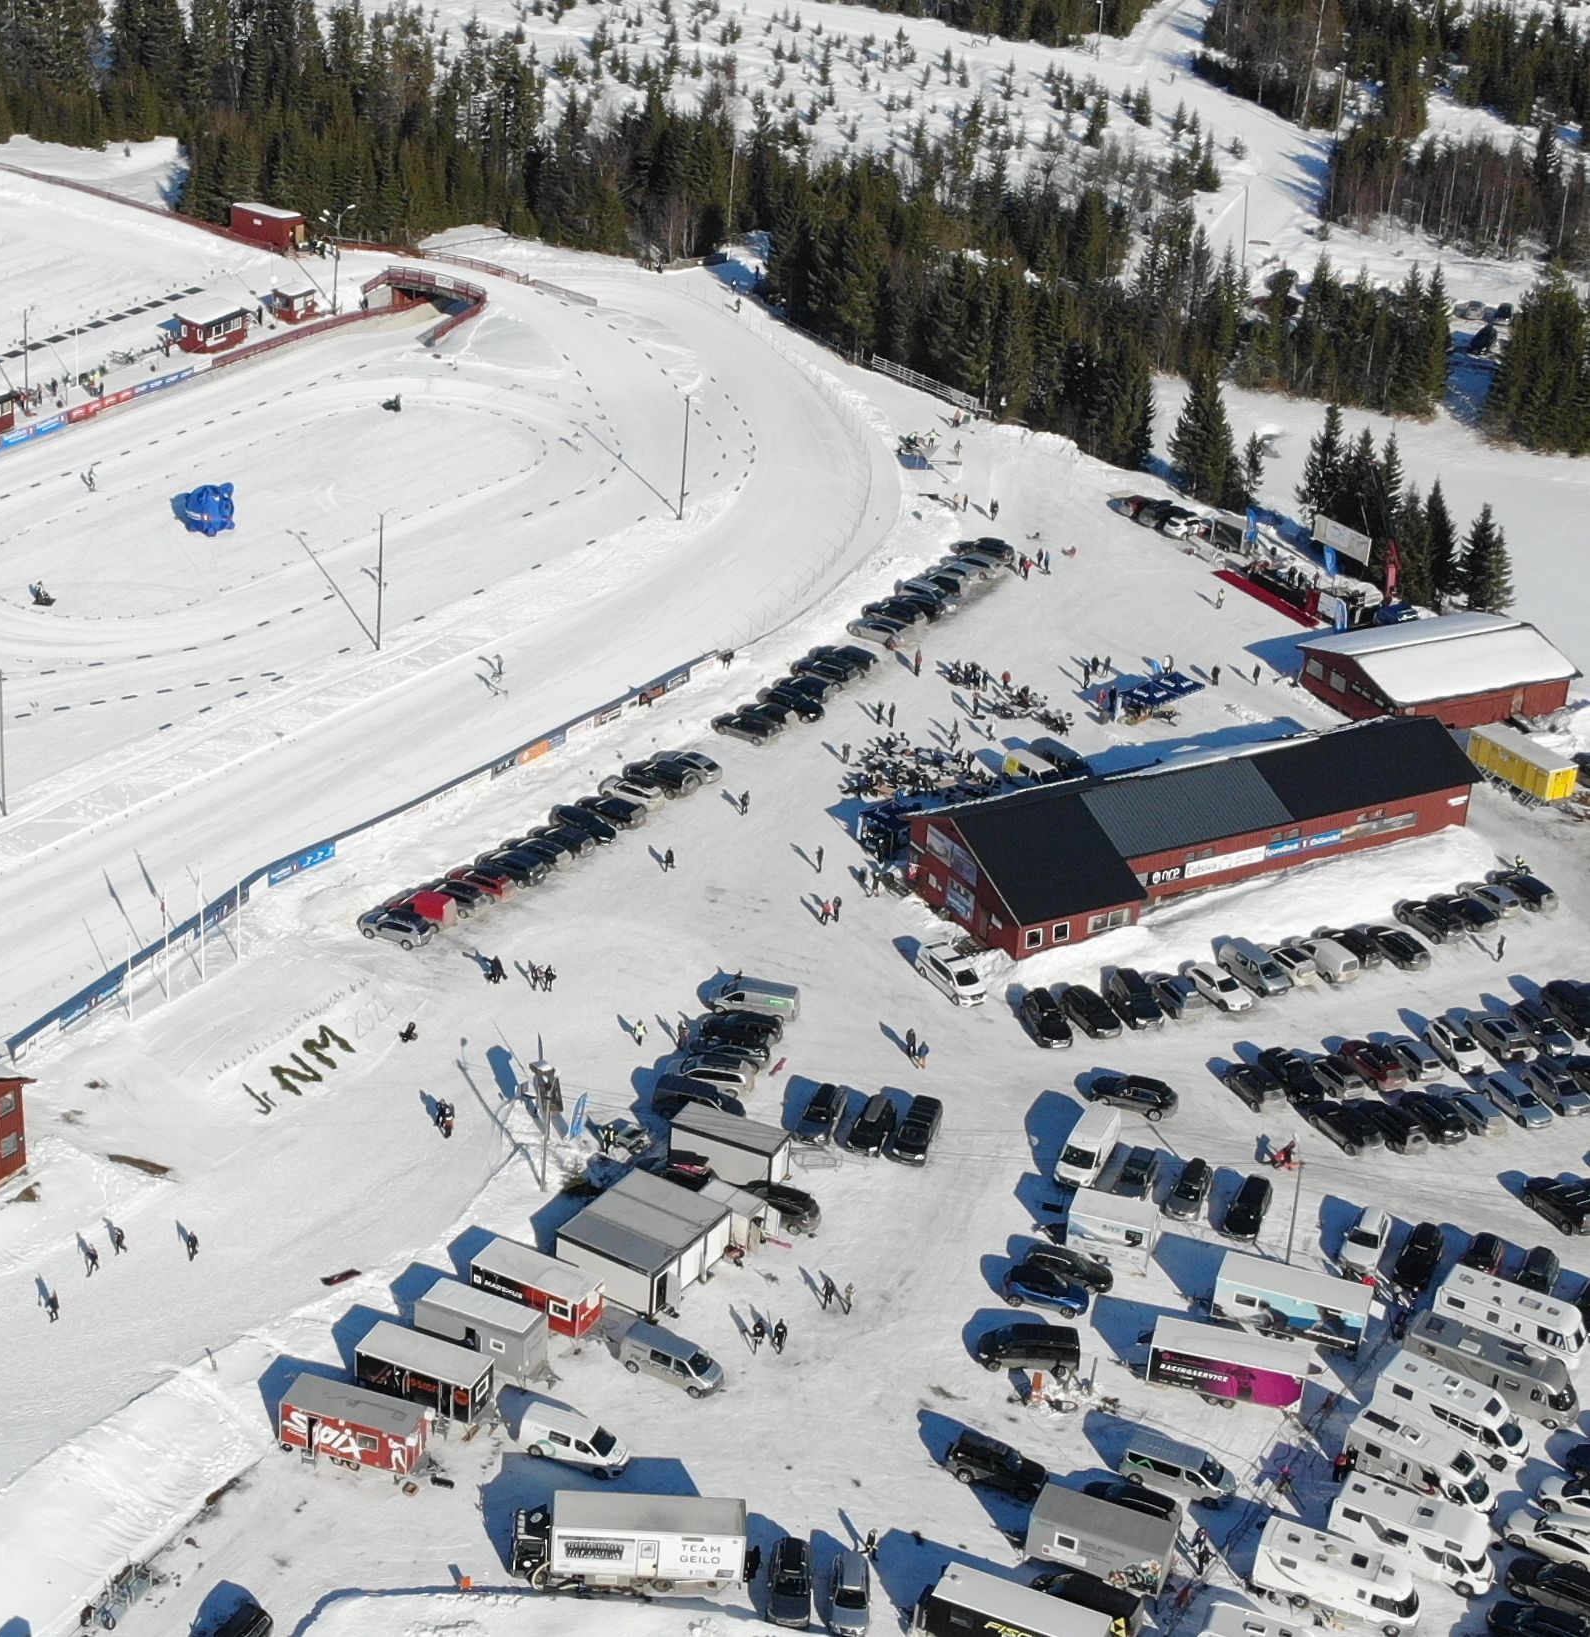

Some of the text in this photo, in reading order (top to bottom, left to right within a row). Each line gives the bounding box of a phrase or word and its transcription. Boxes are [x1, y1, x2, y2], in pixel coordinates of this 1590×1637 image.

[269, 1024, 356, 1096] NM
[483, 1279, 523, 1300] MADSHUS
[682, 1544, 721, 1553] TEAM
[680, 1555, 720, 1564] GEILO
